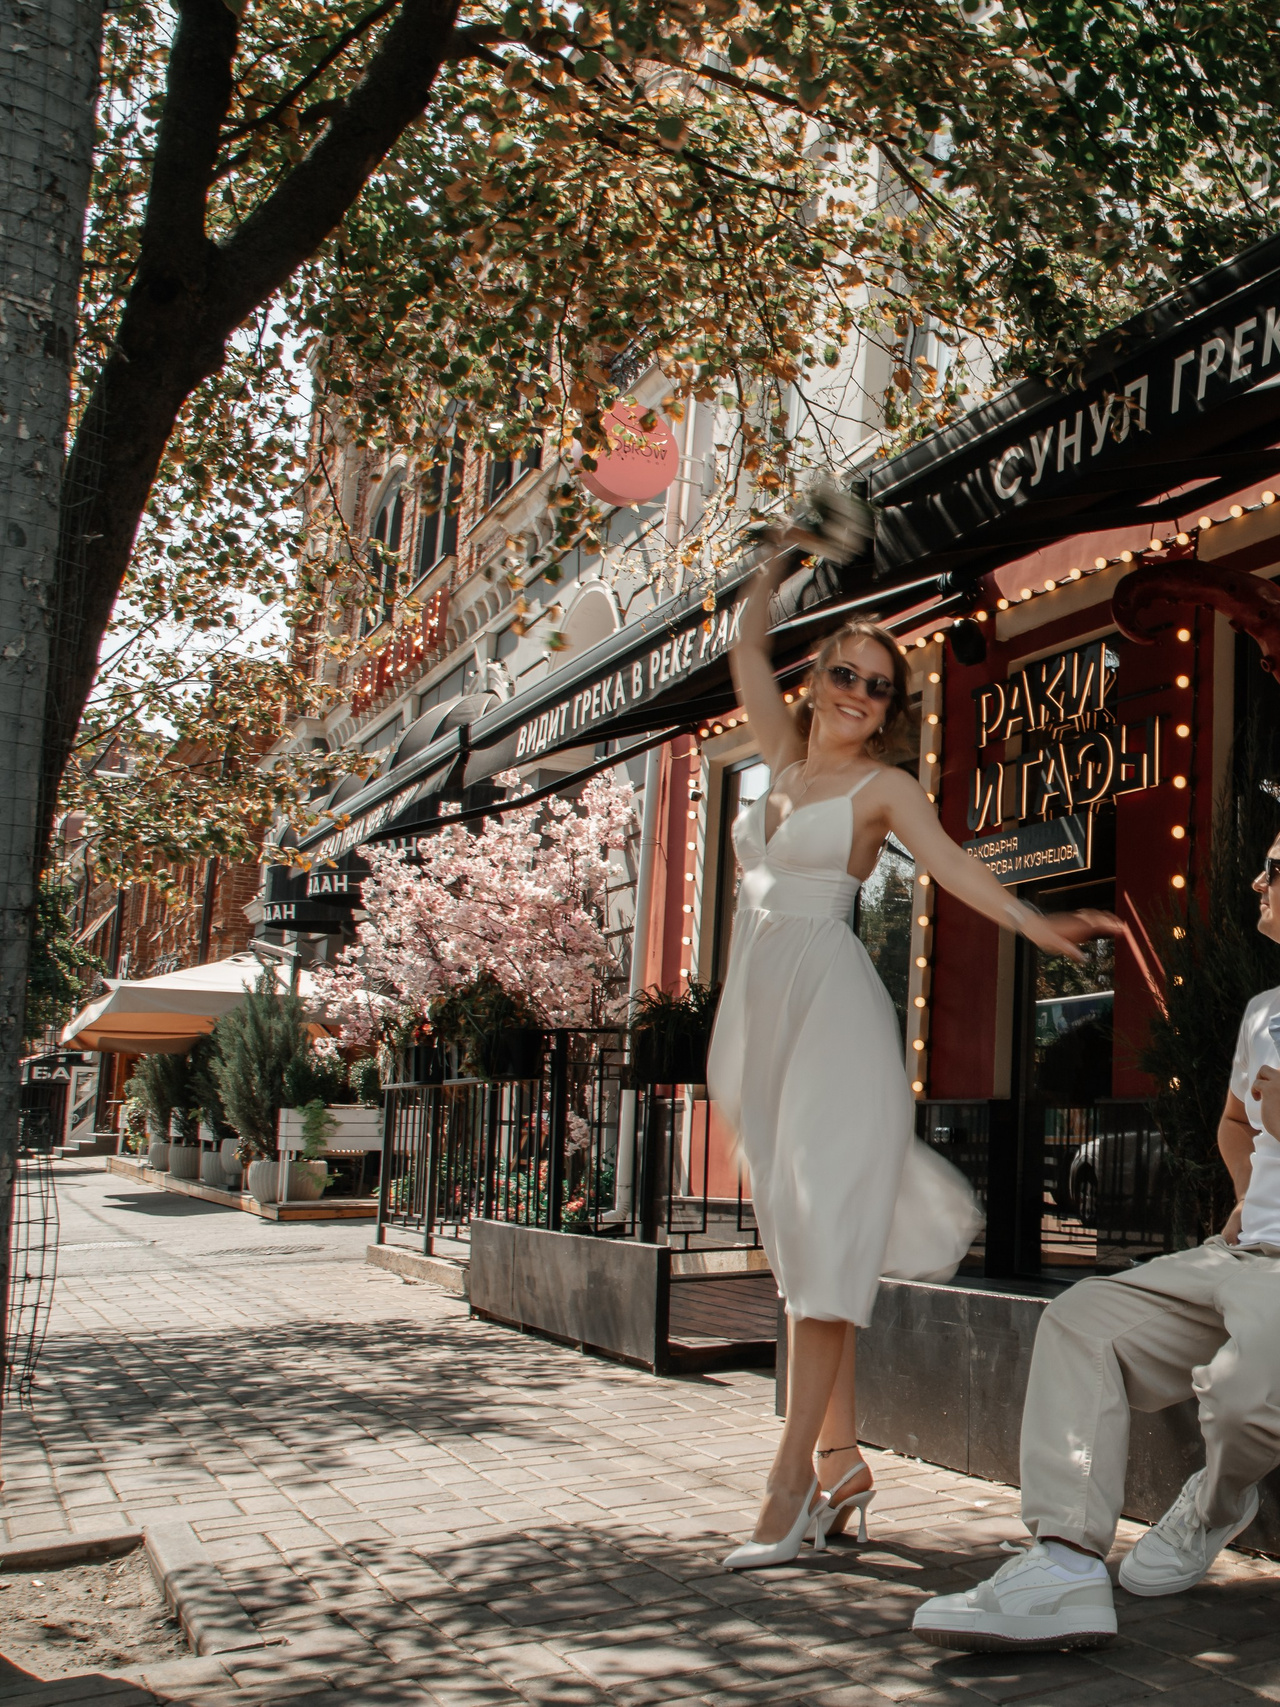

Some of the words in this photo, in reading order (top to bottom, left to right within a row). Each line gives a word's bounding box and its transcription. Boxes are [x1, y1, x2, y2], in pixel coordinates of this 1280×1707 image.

[994, 375, 1148, 499] СУНУЛ
[516, 703, 569, 758] ВИДИТ
[572, 672, 625, 730] ГРЕКА
[632, 661, 643, 699] В
[650, 628, 697, 689] РЕКЕ
[700, 598, 748, 658] РАК
[972, 643, 1105, 748] РАКИ
[967, 761, 1003, 832] И
[1015, 856, 1022, 870] И
[1024, 843, 1079, 868] КУЗНЕЦОВА
